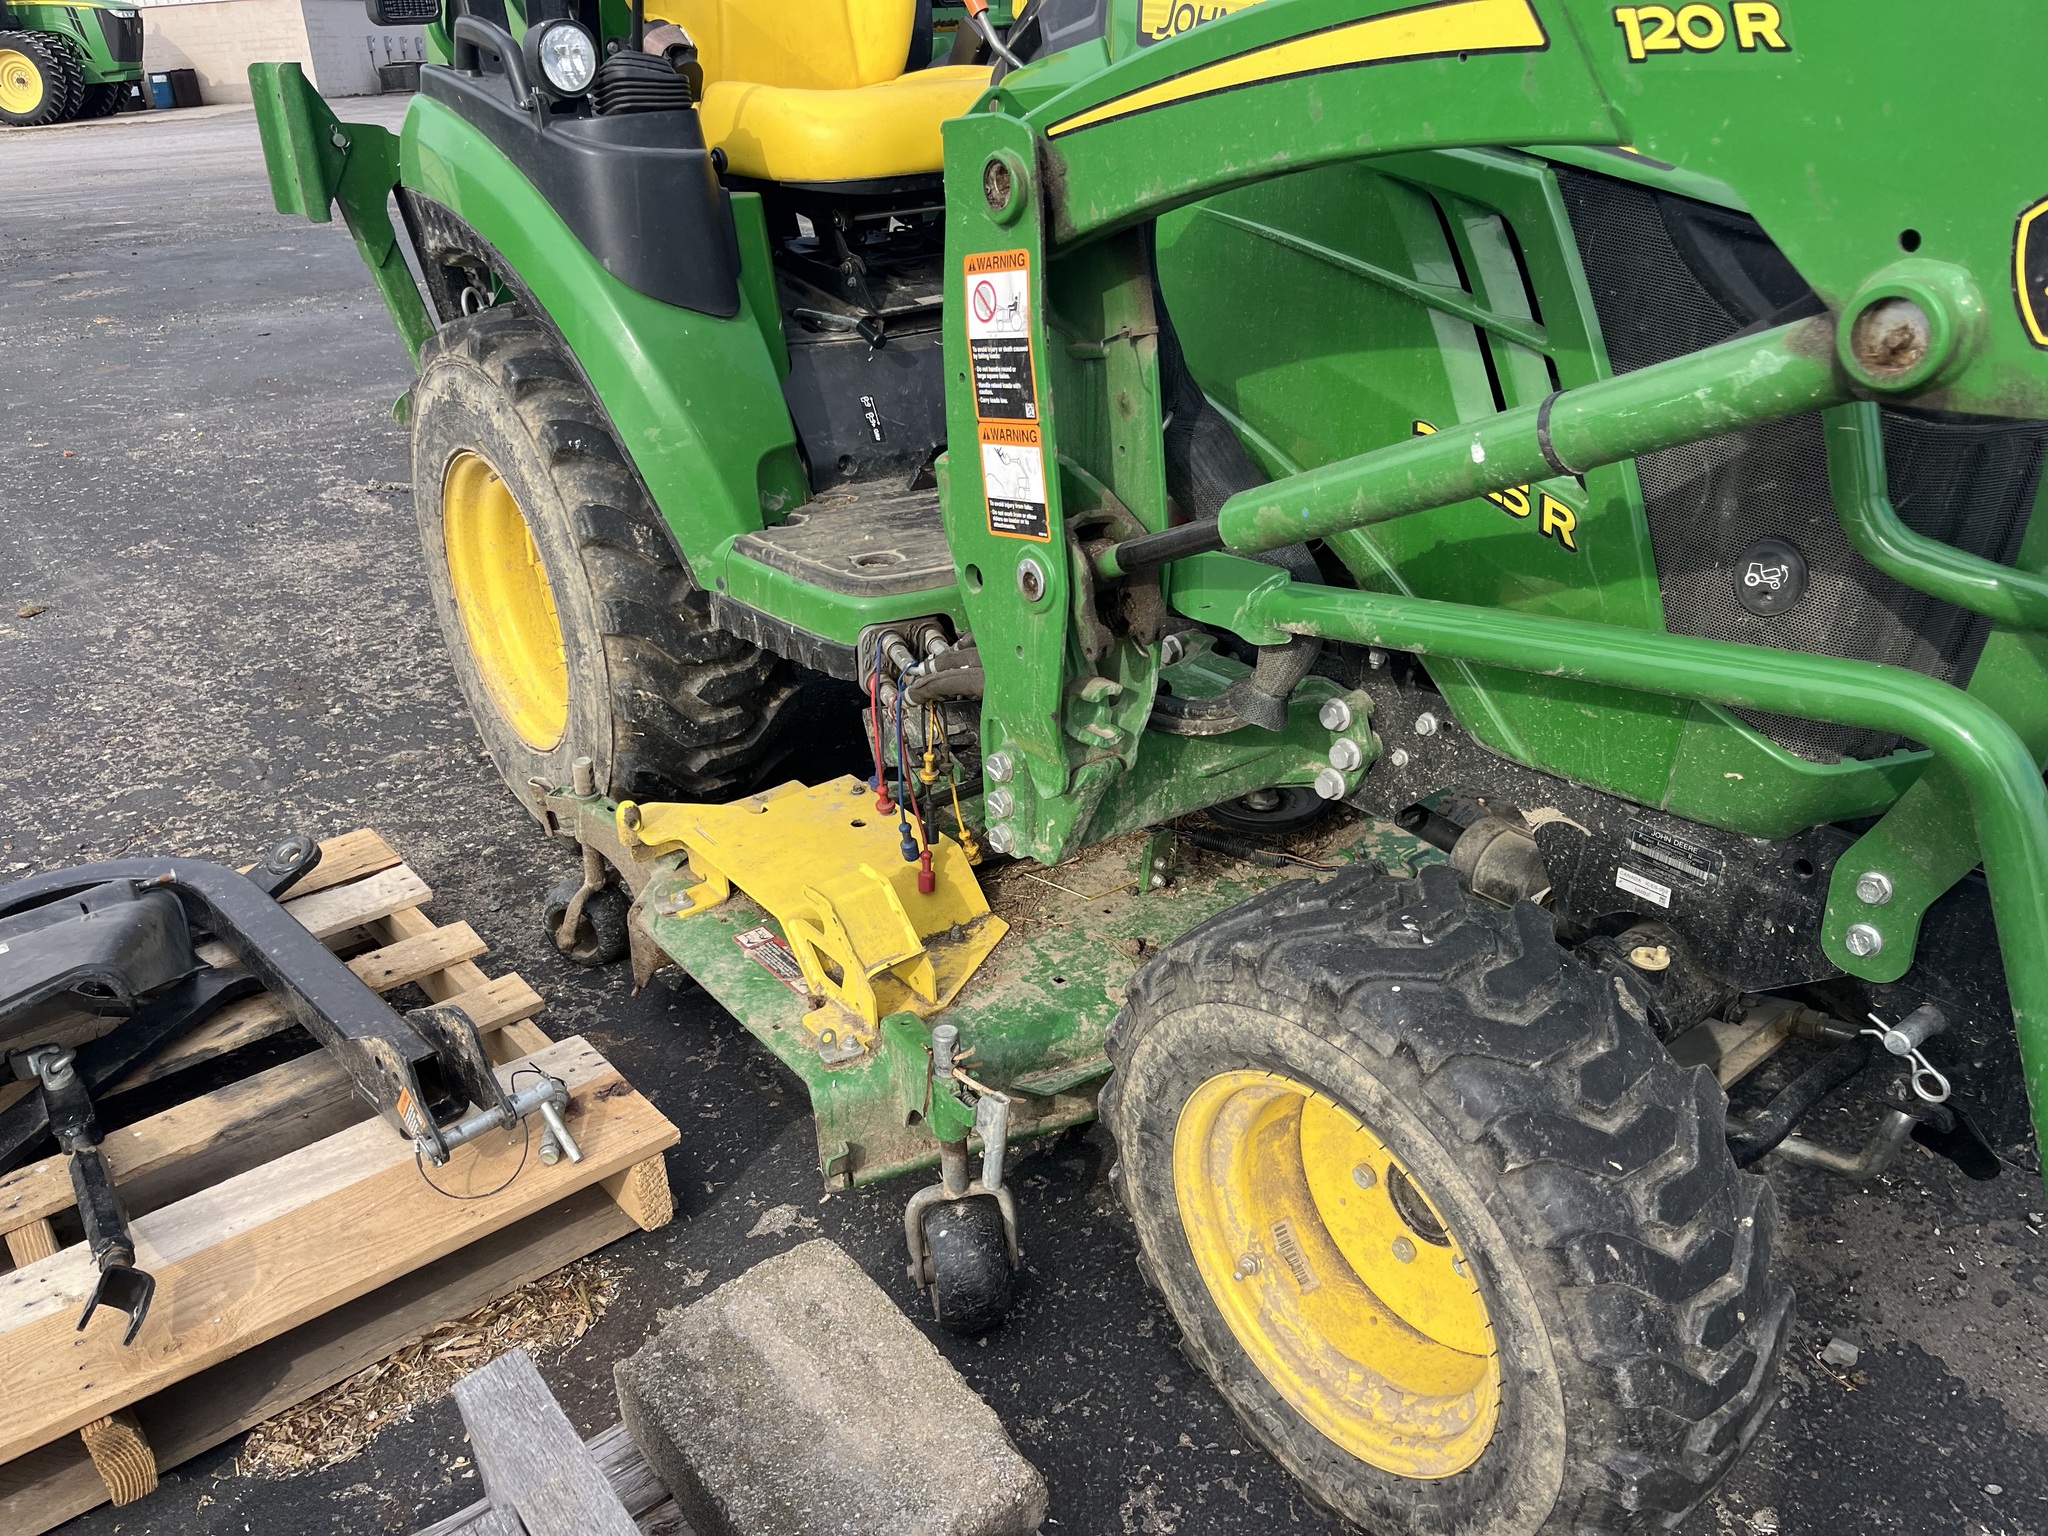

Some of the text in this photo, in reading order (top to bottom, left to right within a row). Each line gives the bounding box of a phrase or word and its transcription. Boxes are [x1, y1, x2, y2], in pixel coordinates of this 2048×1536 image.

[976, 252, 1025, 271] WARNING
[989, 427, 1038, 444] WARNING
[1651, 831, 1671, 843] JOHN
[1673, 838, 1699, 855] DEERE
[1619, 870, 1642, 884] CANADA
